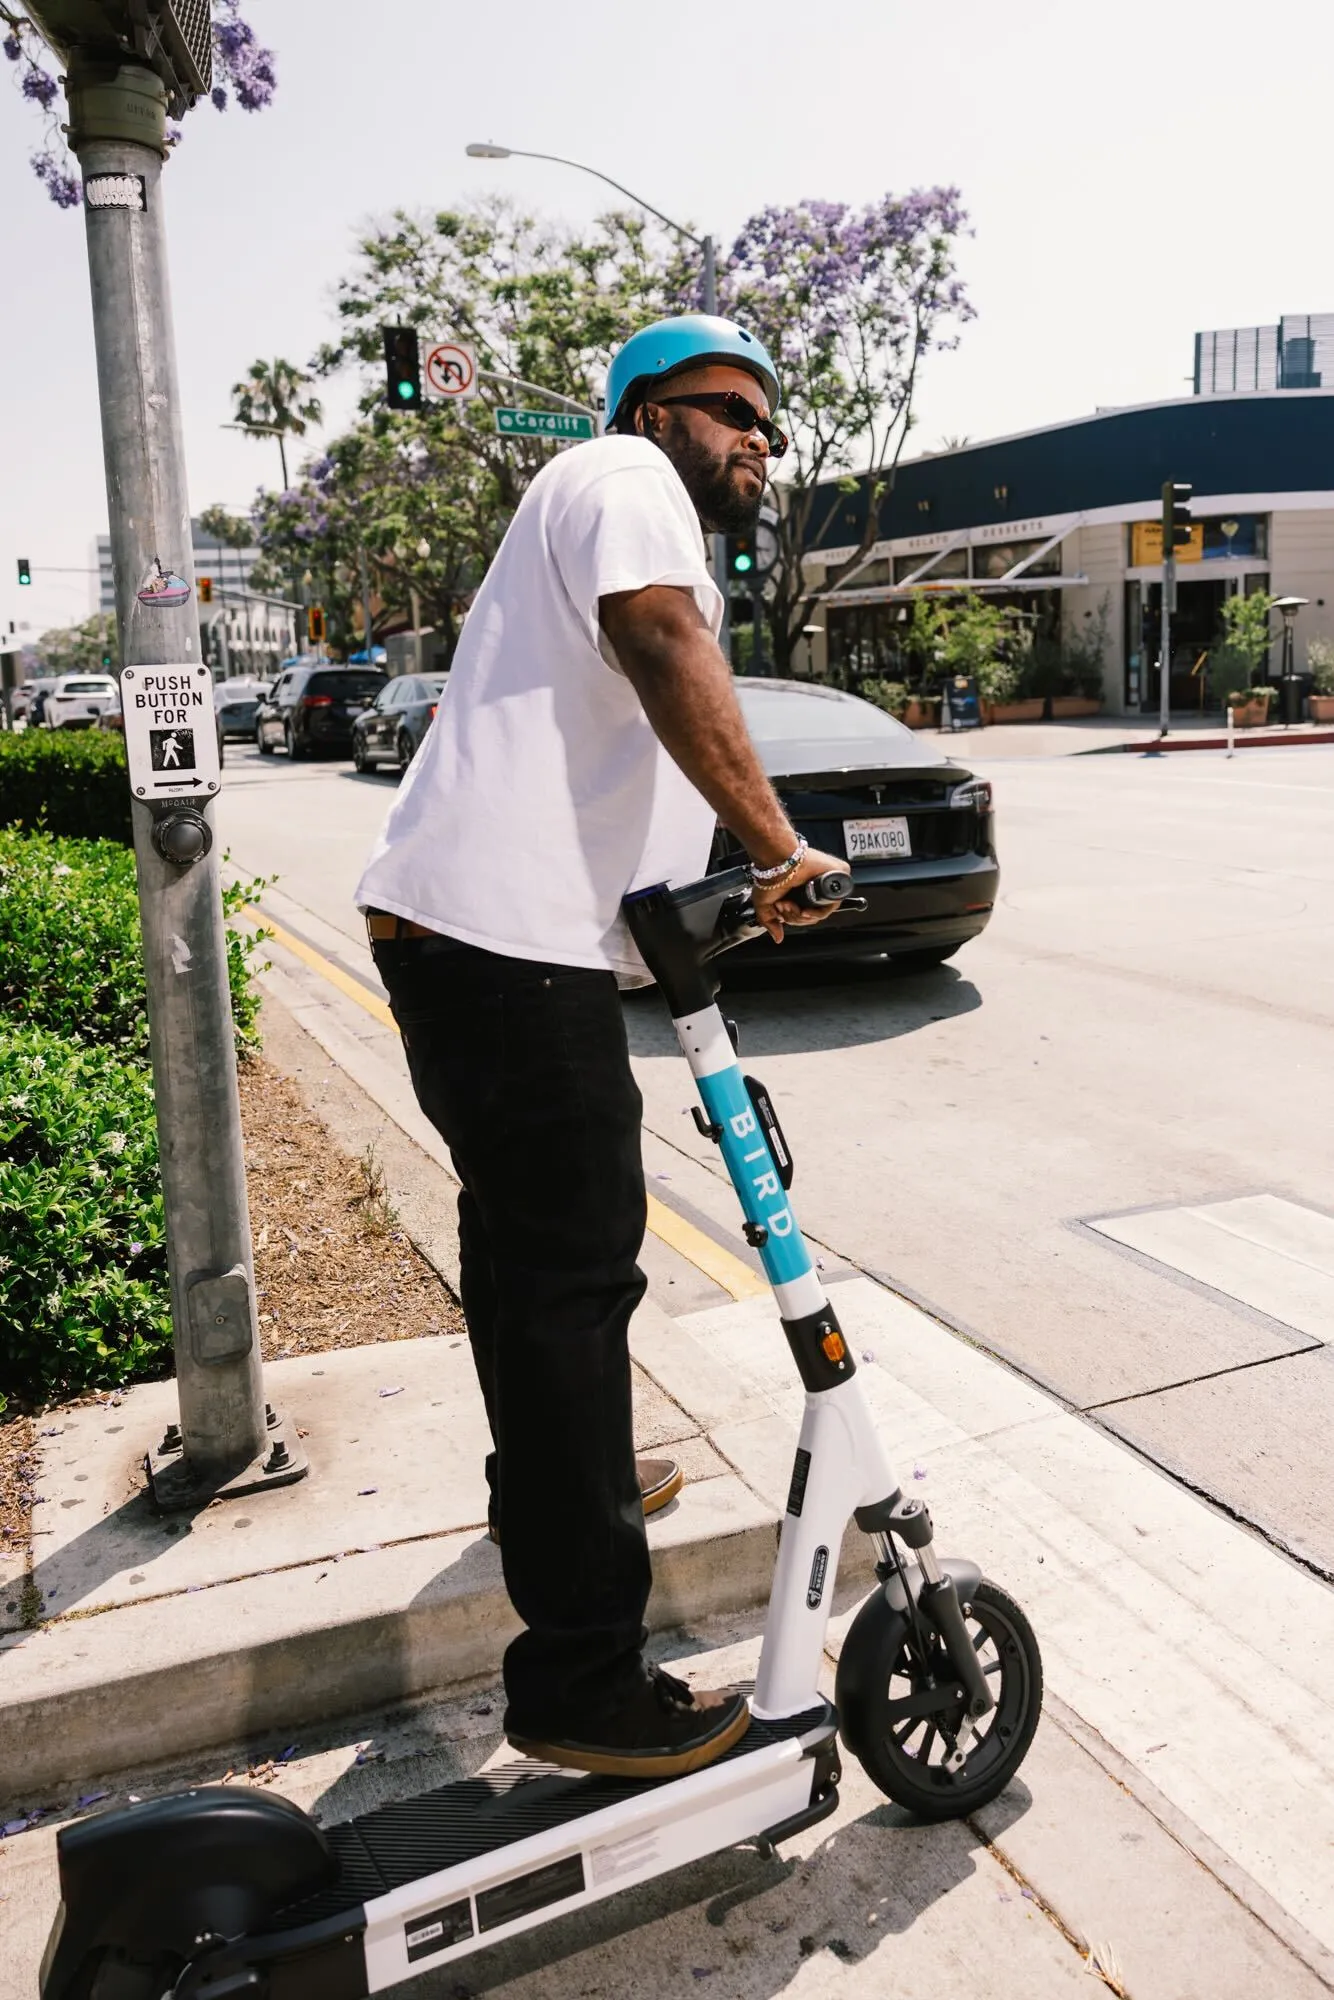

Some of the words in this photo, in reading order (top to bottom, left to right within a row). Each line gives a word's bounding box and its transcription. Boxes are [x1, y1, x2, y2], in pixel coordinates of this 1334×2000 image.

[515, 413, 578, 431] Cardiff
[144, 675, 191, 691] PUSH
[135, 691, 203, 708] BUTTON
[154, 709, 187, 724] FOR
[850, 831, 905, 851] 9BAK080
[729, 1105, 793, 1238] BIRD
